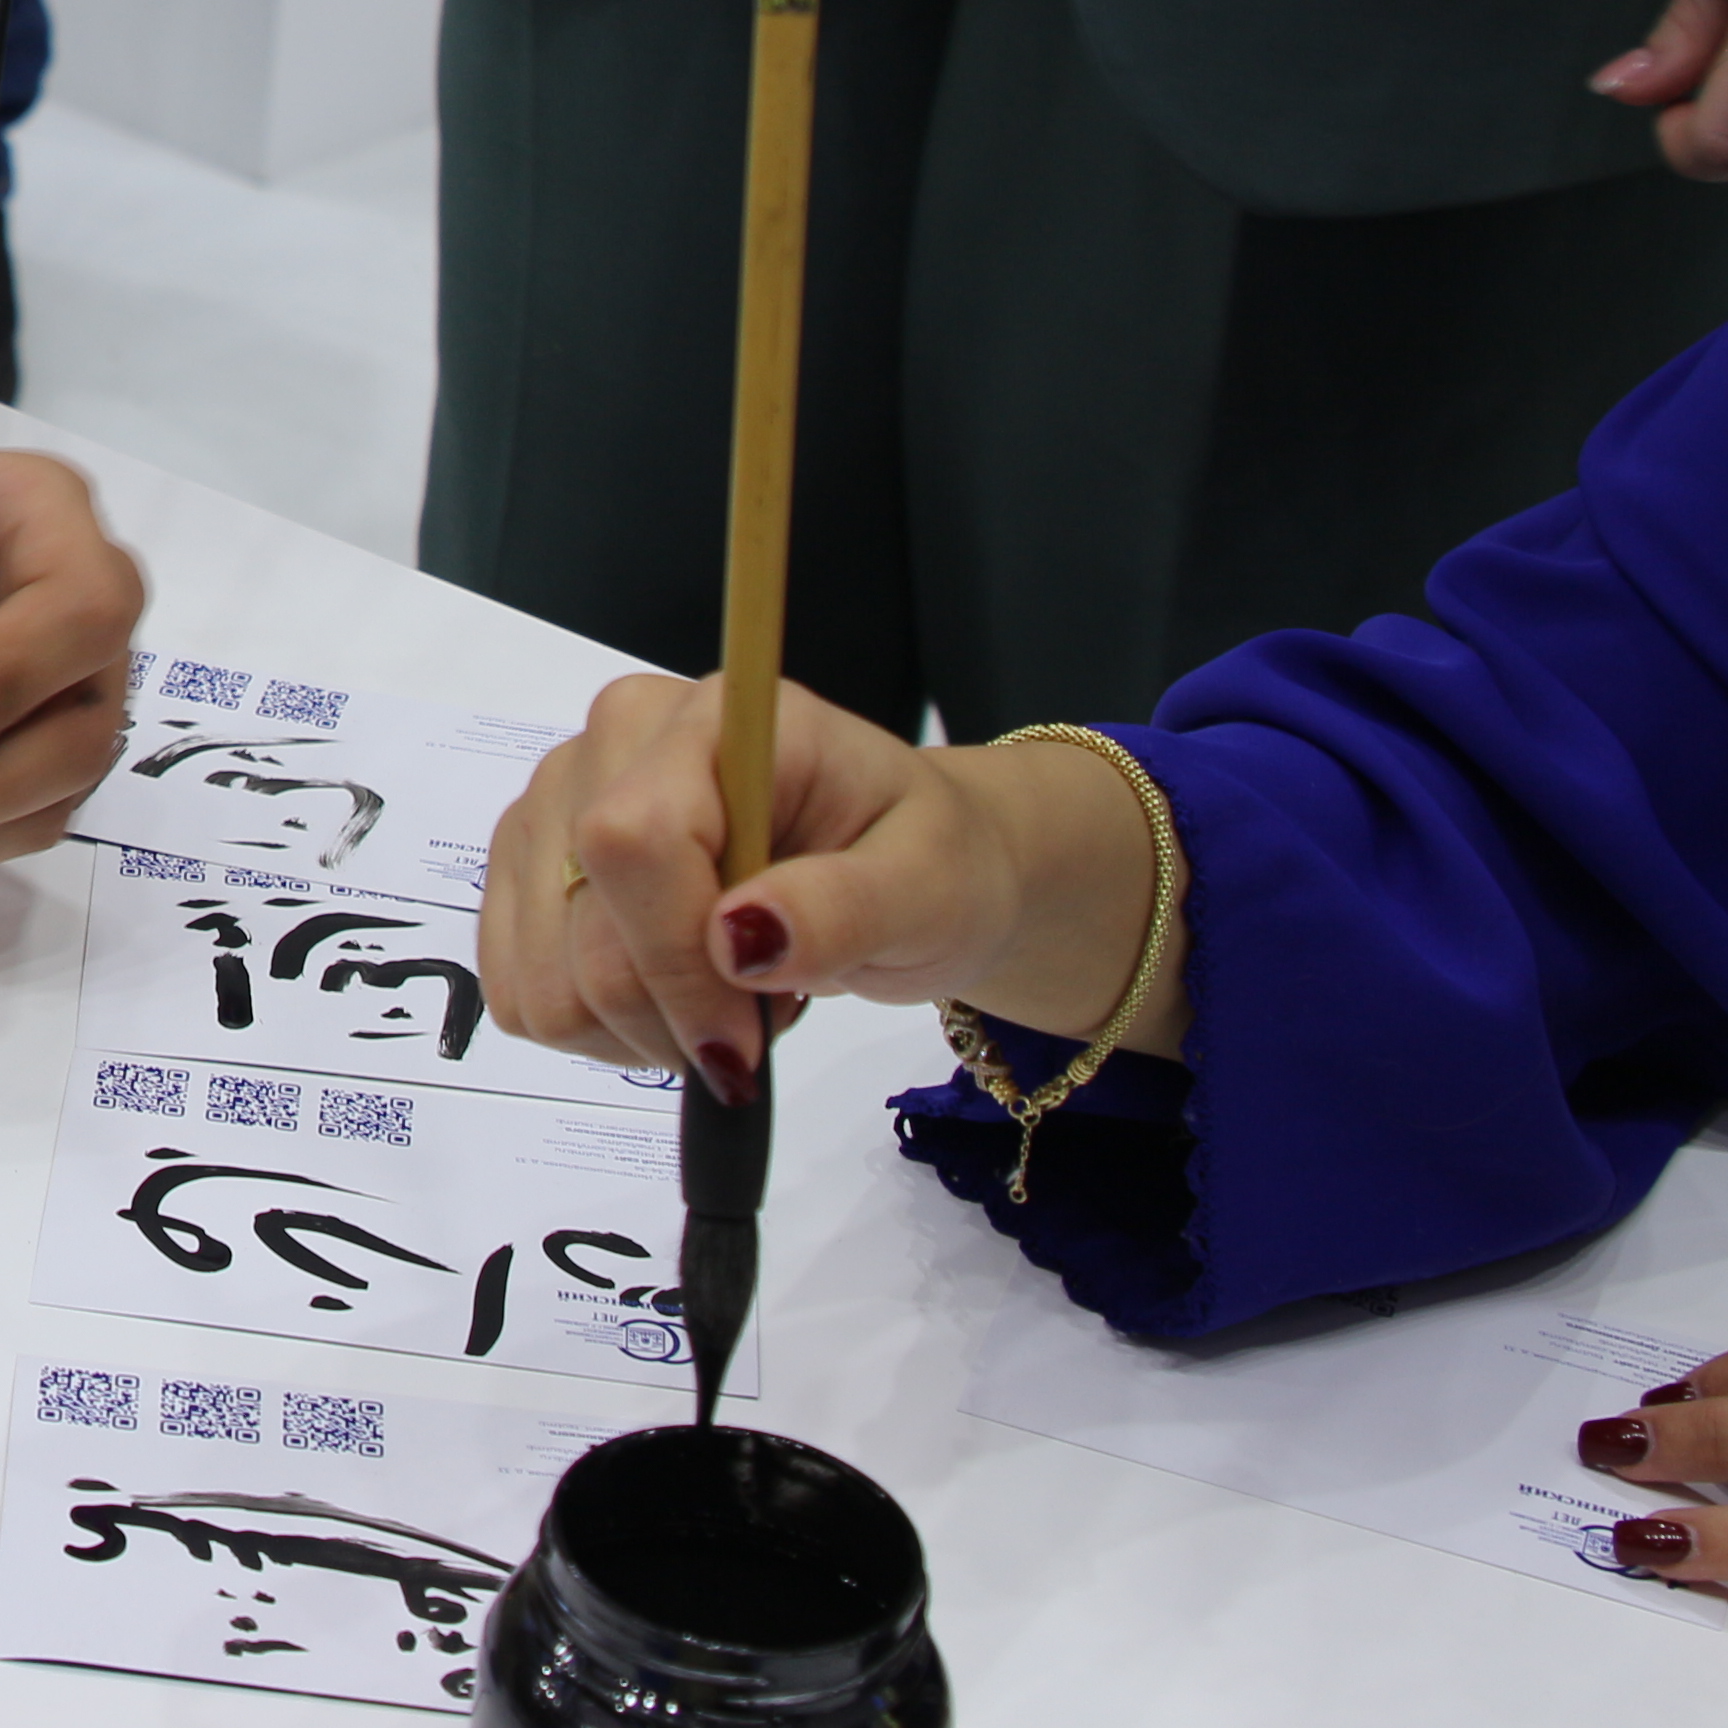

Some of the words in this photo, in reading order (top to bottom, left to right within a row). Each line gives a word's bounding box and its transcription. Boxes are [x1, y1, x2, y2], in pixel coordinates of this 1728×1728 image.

[429, 839, 487, 854] нский
[593, 1312, 619, 1323] ЛЕТ
[1550, 1510, 1582, 1526] ЛЕТ
